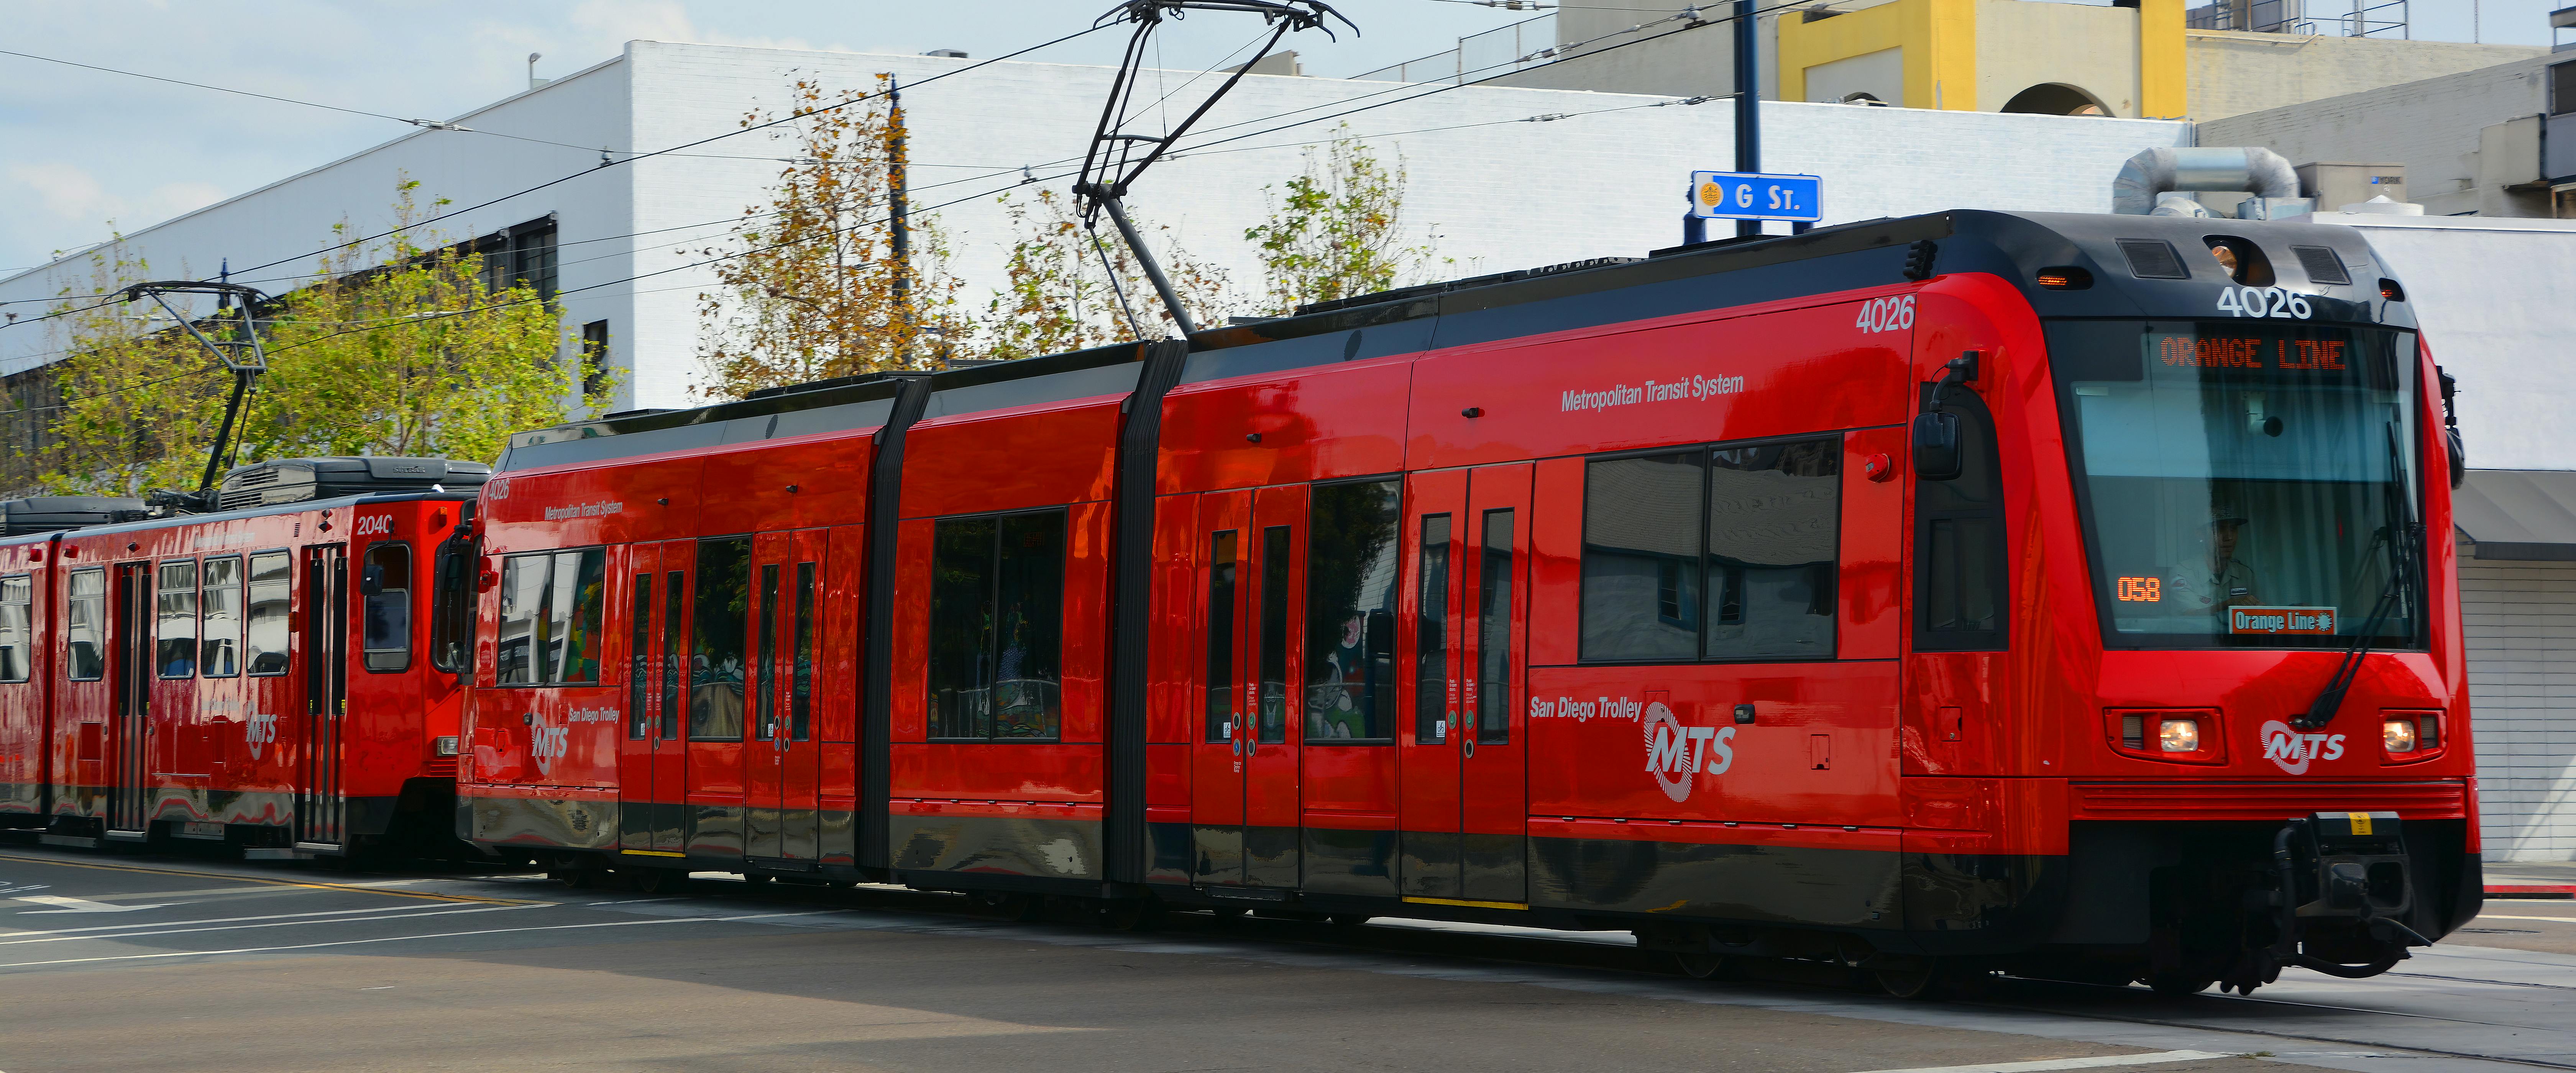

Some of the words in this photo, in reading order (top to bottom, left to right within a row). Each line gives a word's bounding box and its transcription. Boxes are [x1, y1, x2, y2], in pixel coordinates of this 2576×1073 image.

[1735, 184, 1753, 208] G
[1856, 295, 1915, 334] 4026
[2217, 286, 2312, 319] 4026
[2161, 337, 2262, 368] ORANGE
[2278, 340, 2346, 369] LINE
[1561, 383, 1642, 413] Metropolitan
[1645, 377, 1689, 402] Transit
[1692, 374, 1744, 401] System
[489, 478, 511, 500] 4026
[545, 504, 580, 522] Metropolitan
[581, 501, 600, 517] Transit
[600, 500, 623, 518] System
[2118, 577, 2161, 602] 058
[2235, 611, 2285, 632] Orange
[2287, 611, 2316, 630] Line
[569, 707, 580, 722] San
[581, 707, 599, 725] Diego
[599, 707, 620, 724] Trolley
[1530, 696, 1555, 718] San
[1558, 696, 1596, 722] Diego
[1599, 696, 1643, 722] Trolley
[245, 714, 277, 743] MTS
[532, 727, 569, 758] MTS
[1645, 727, 1737, 775] MTS
[2262, 733, 2346, 760] MTS
